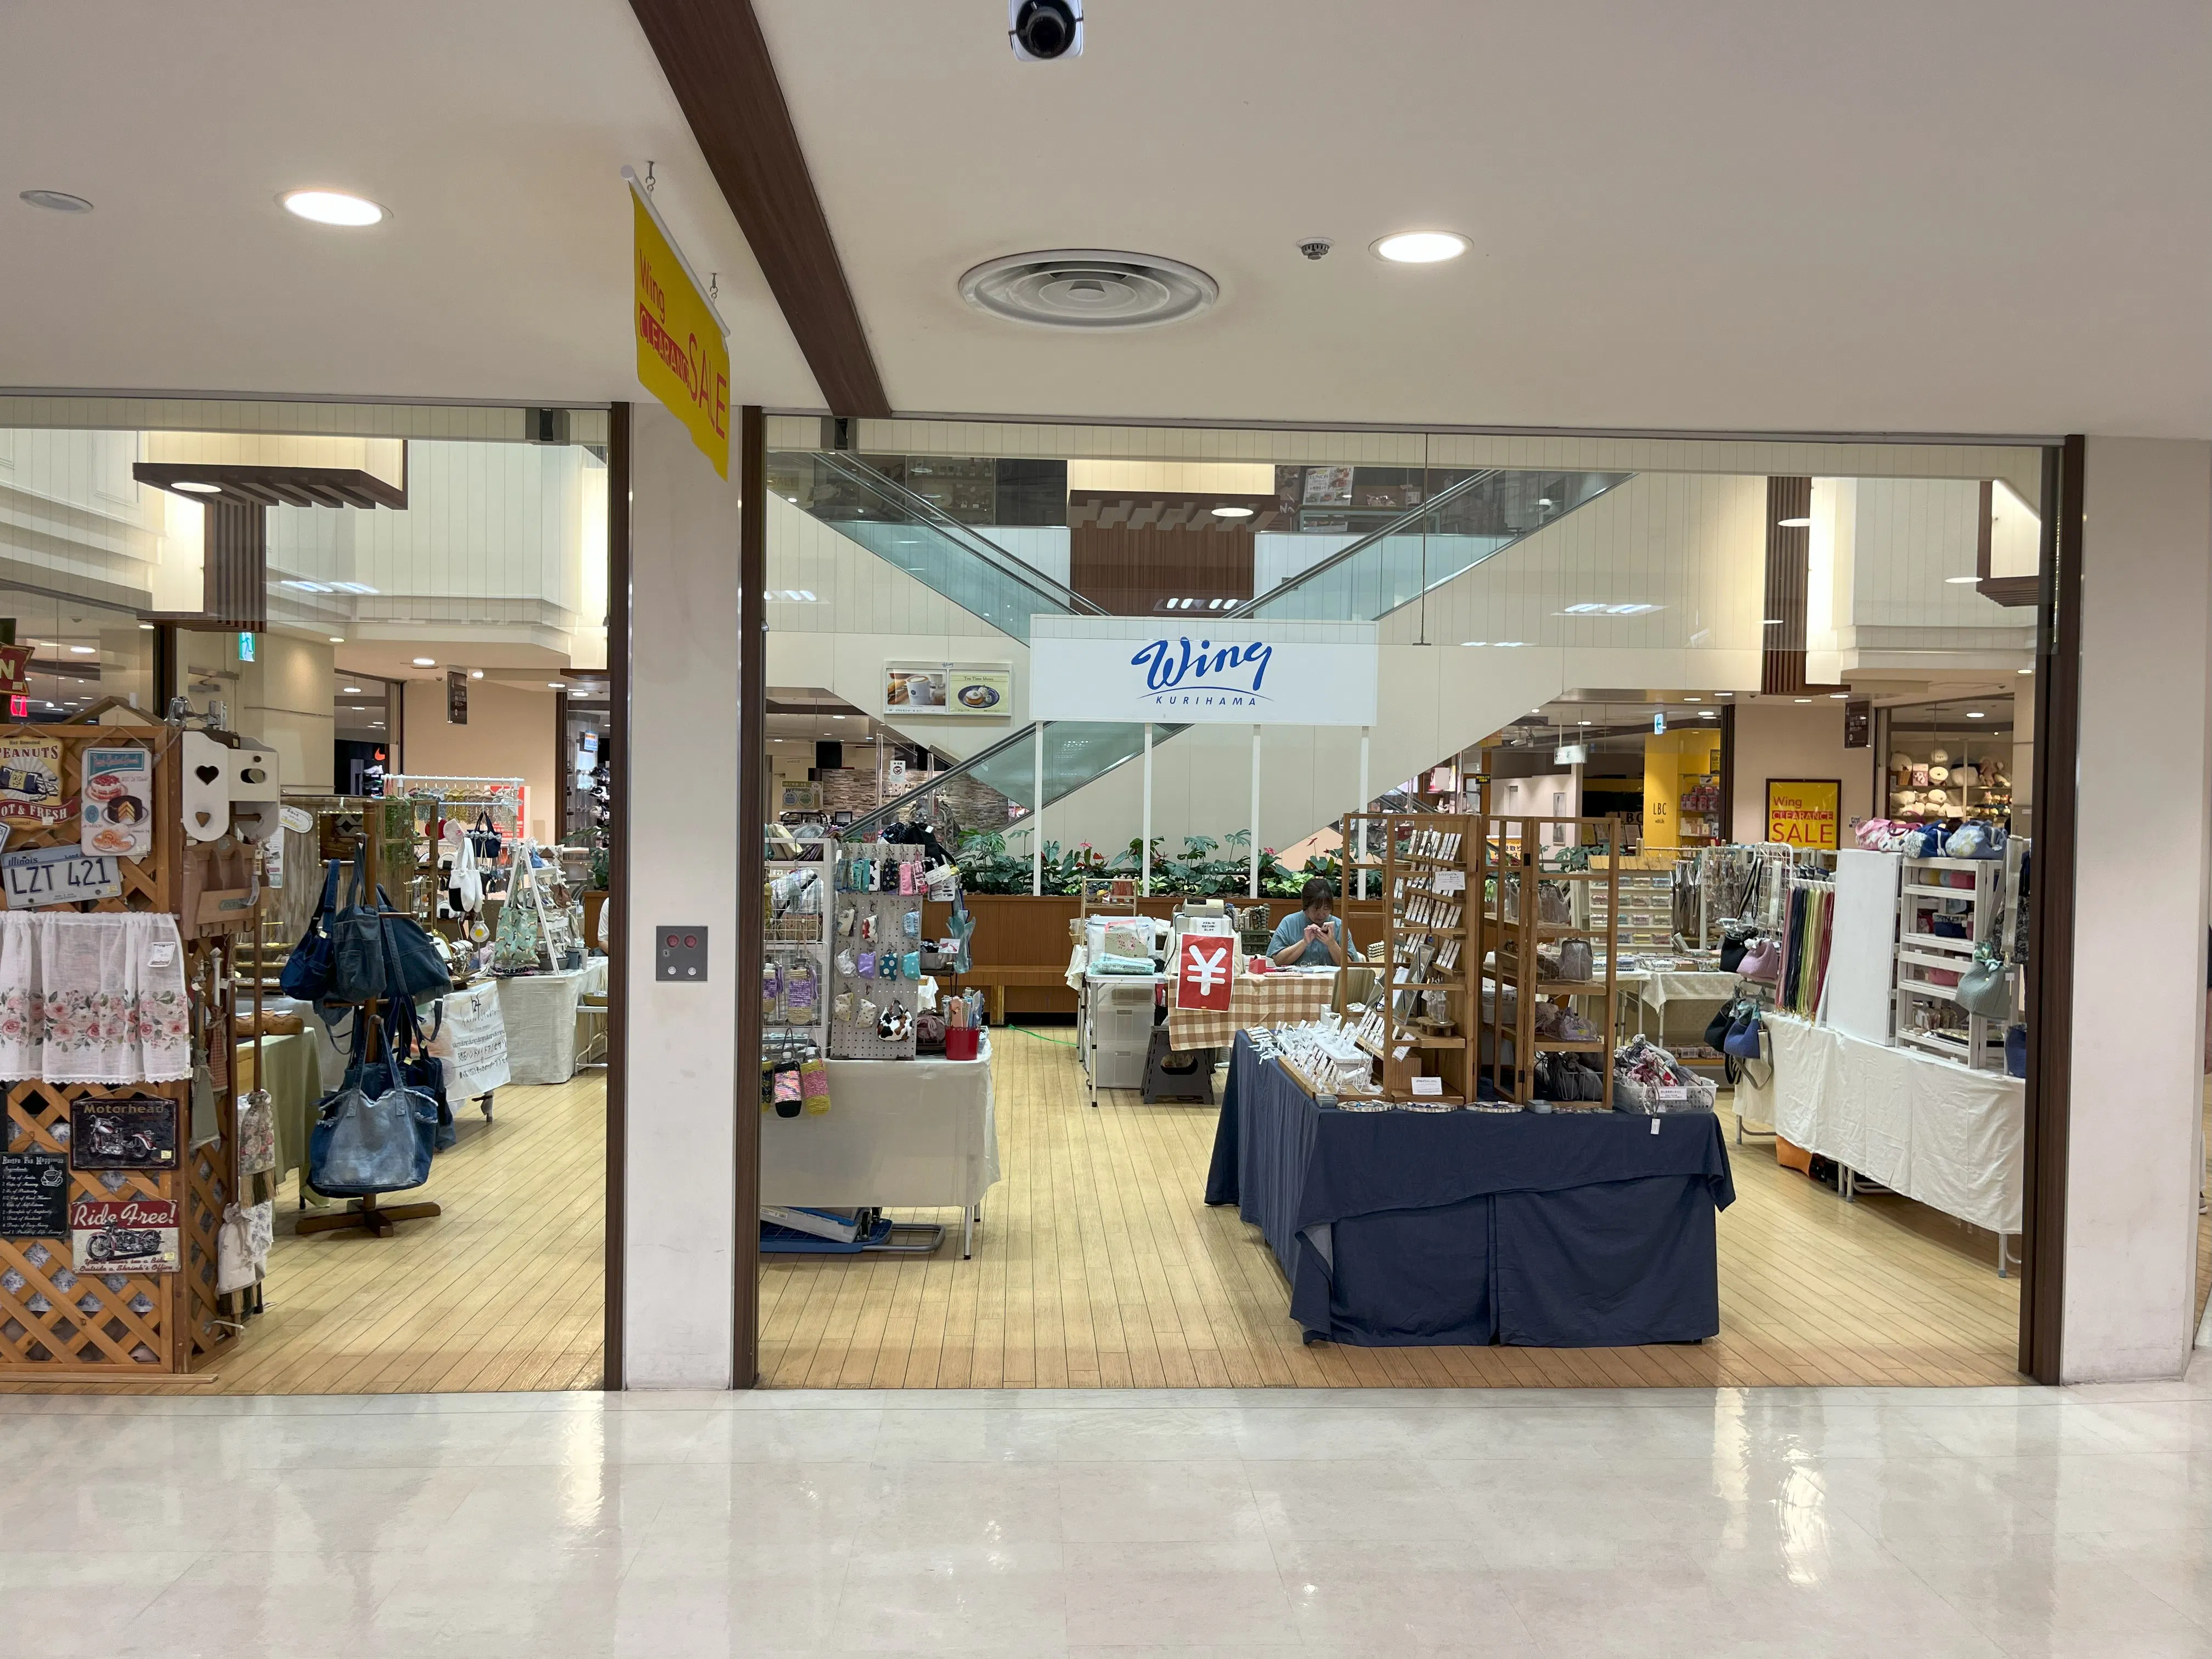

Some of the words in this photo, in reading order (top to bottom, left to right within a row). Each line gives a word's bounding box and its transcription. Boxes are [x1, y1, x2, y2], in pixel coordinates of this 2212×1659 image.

[640, 249, 665, 324] Wing
[689, 332, 726, 440] SALE
[1131, 636, 1272, 691] Wing
[1156, 696, 1256, 706] KURIHAMA
[1653, 803, 1667, 815] LBC
[1773, 795, 1802, 809] Wing
[1, 804, 15, 816] OT
[30, 805, 67, 820] FRESH
[1773, 812, 1833, 820] CLEARANCE
[862, 832, 876, 843] SA
[1771, 822, 1833, 843] SALE
[8, 856, 38, 866] Illinois
[10, 864, 54, 895] LZT
[68, 857, 111, 887] 421
[83, 1104, 164, 1114] Motorhead
[74, 1203, 117, 1226] Ride
[121, 1202, 176, 1226] Free!
